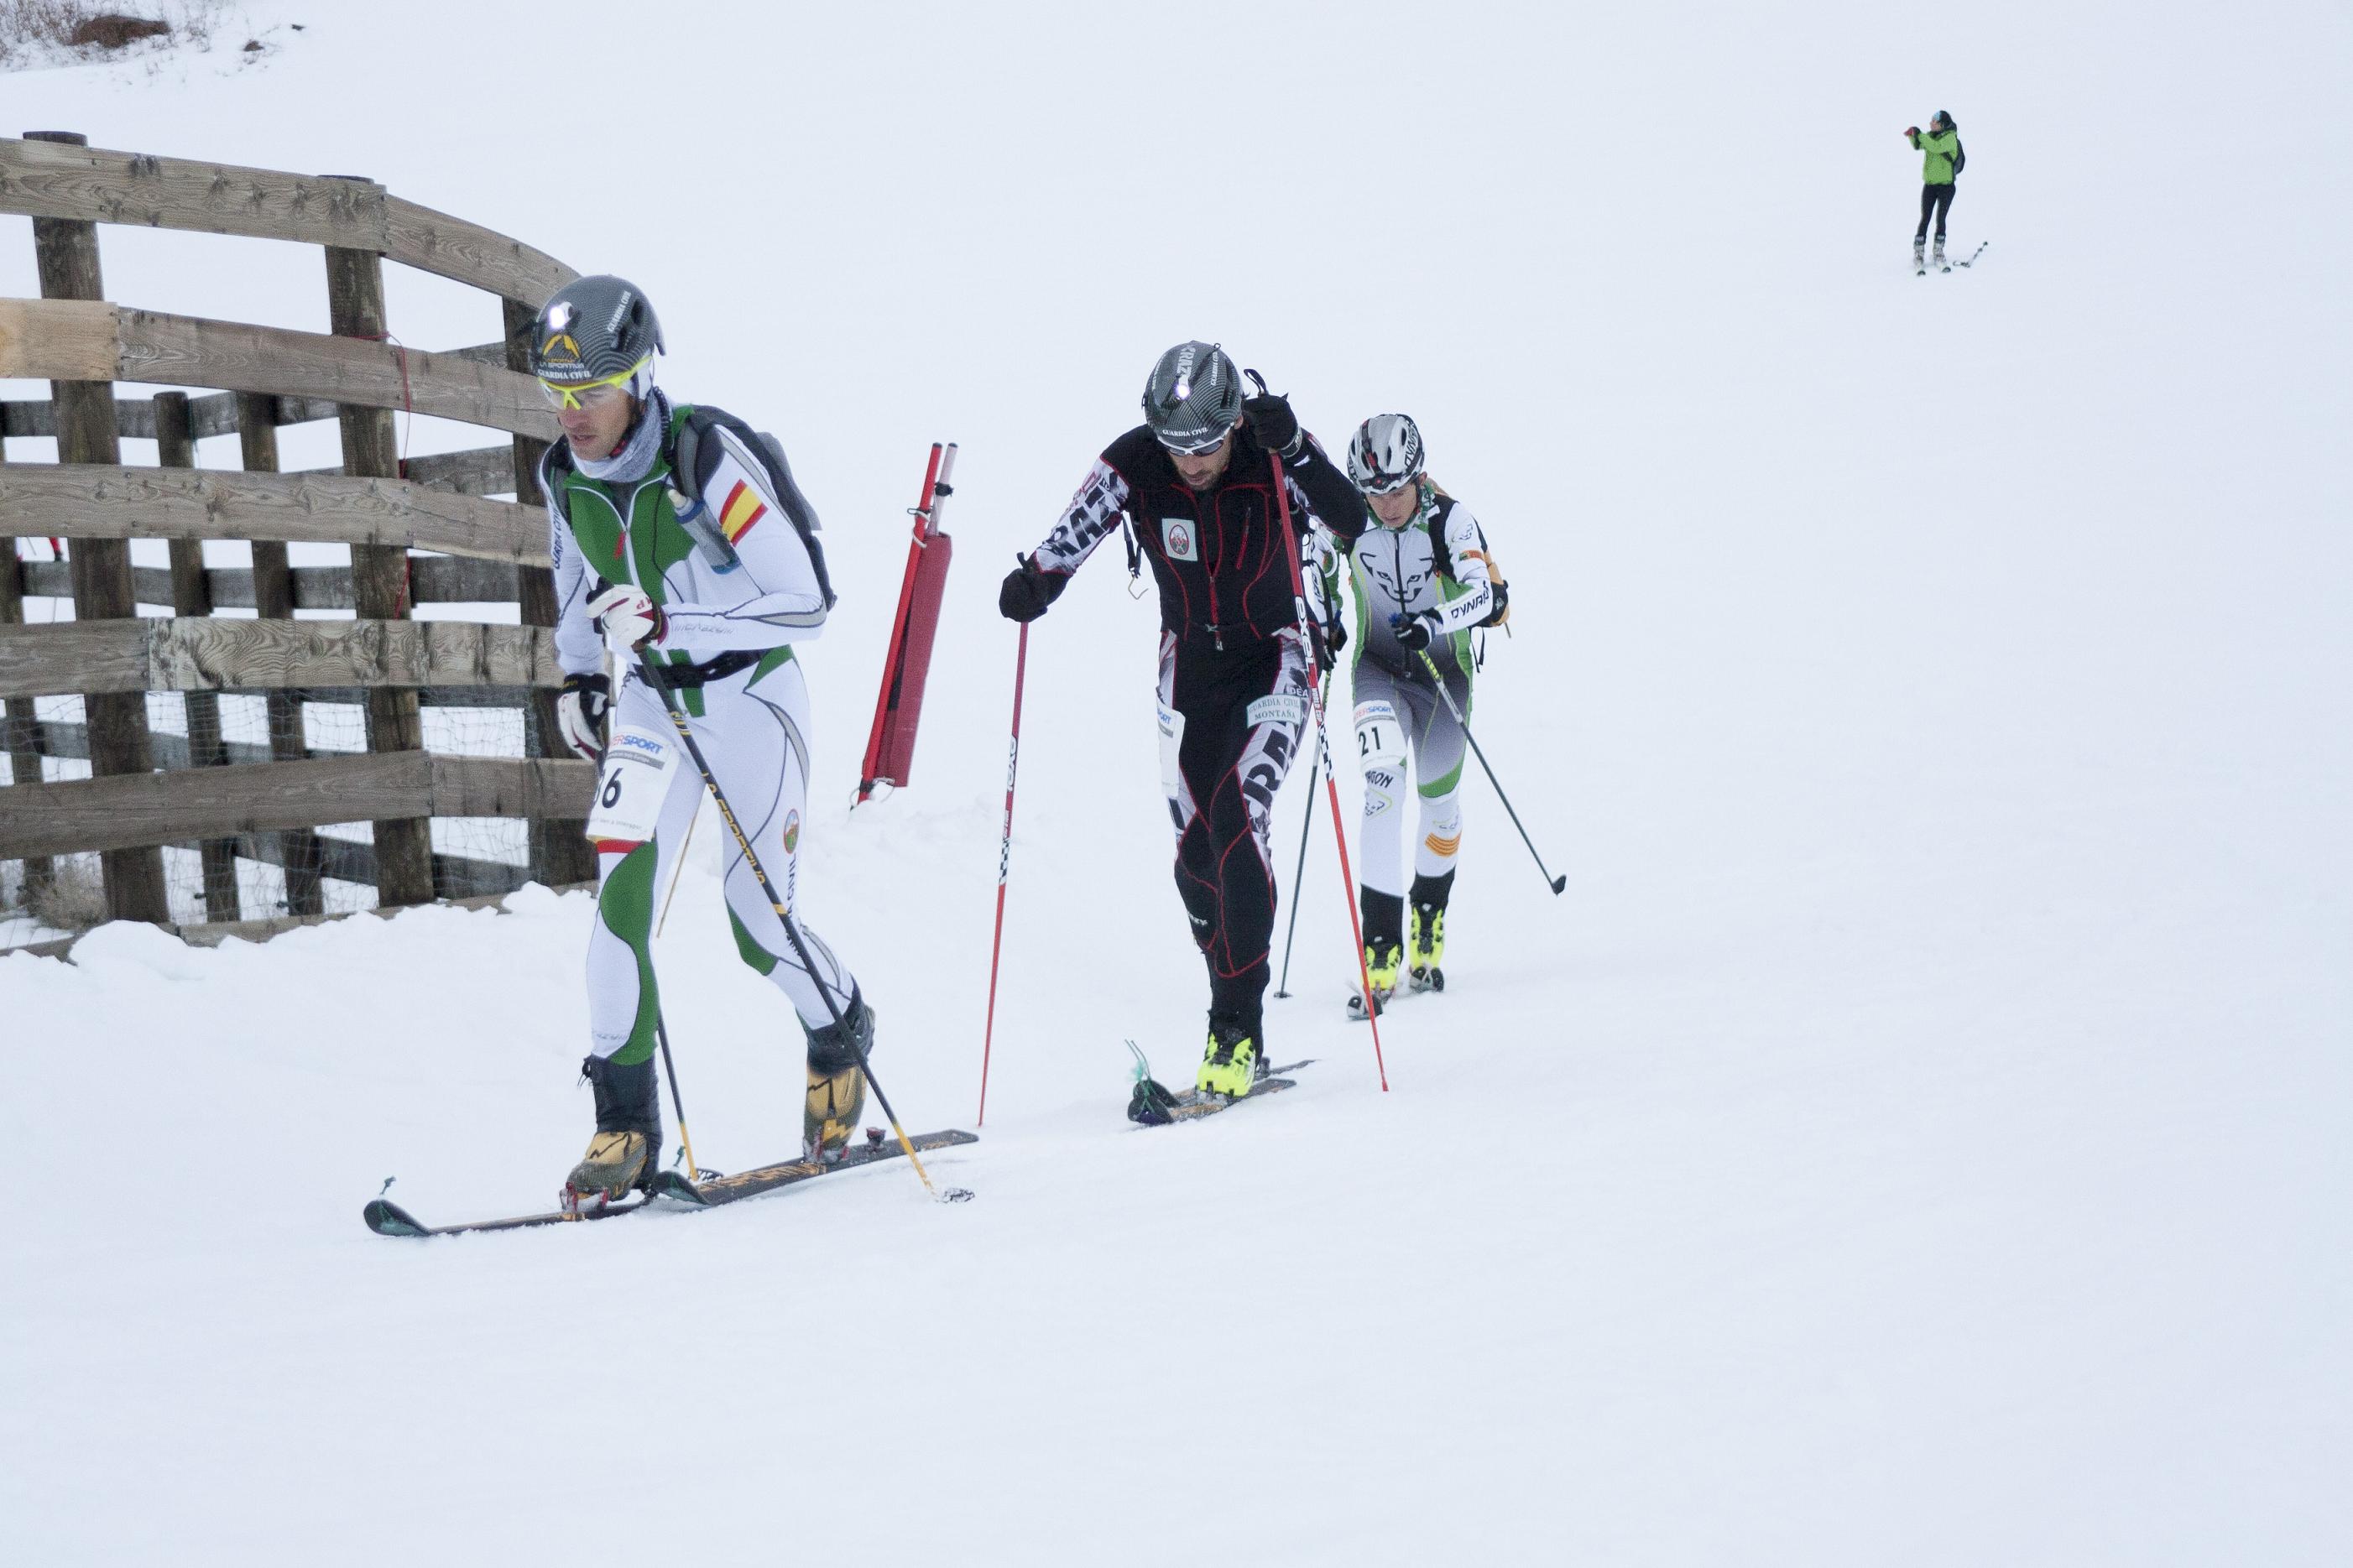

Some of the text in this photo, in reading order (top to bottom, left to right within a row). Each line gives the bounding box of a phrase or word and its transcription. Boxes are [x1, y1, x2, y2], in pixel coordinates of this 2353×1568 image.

[570, 370, 592, 379] CIVIL
[1192, 427, 1208, 435] CIVIL
[1249, 698, 1300, 714] GUARDIA CIVIL
[1359, 727, 1380, 757] 21
